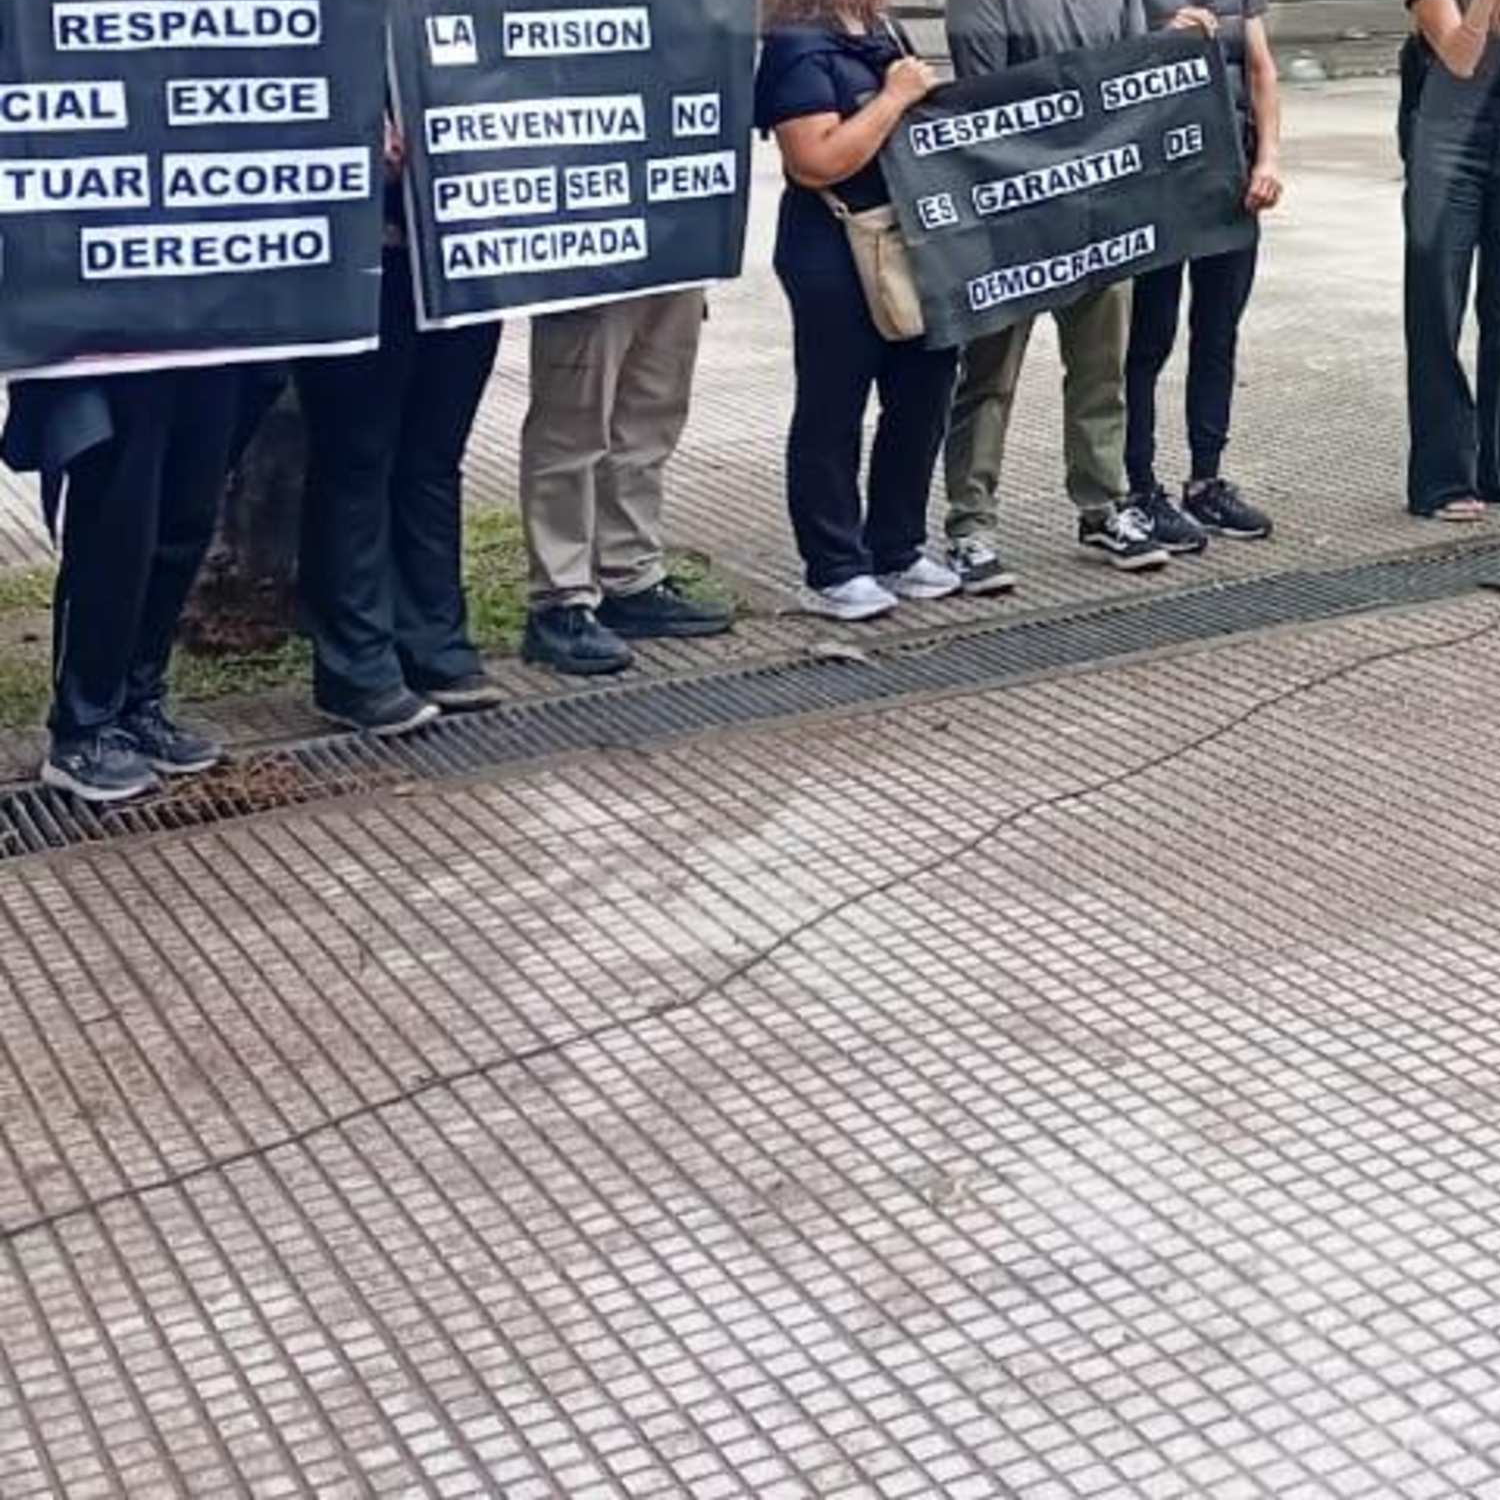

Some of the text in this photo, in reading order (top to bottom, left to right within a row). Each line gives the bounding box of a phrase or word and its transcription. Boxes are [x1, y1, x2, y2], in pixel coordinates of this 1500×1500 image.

[58, 7, 318, 46] RESPALDO
[432, 19, 645, 51] LA PRISION
[2, 83, 318, 122] CIAL EXIGE
[430, 102, 718, 145] PREVENTIVA NO
[912, 61, 1207, 152] RESPALDO SOCIAL
[5, 162, 364, 200] TUAR ACORDE
[438, 162, 730, 211] PUEDE SER PENA
[922, 128, 1201, 225] ES GARANTIA DE
[86, 230, 324, 272] DERECHO
[448, 226, 642, 271] ANTICIPADA
[970, 232, 1150, 306] DEMOCRACIA
